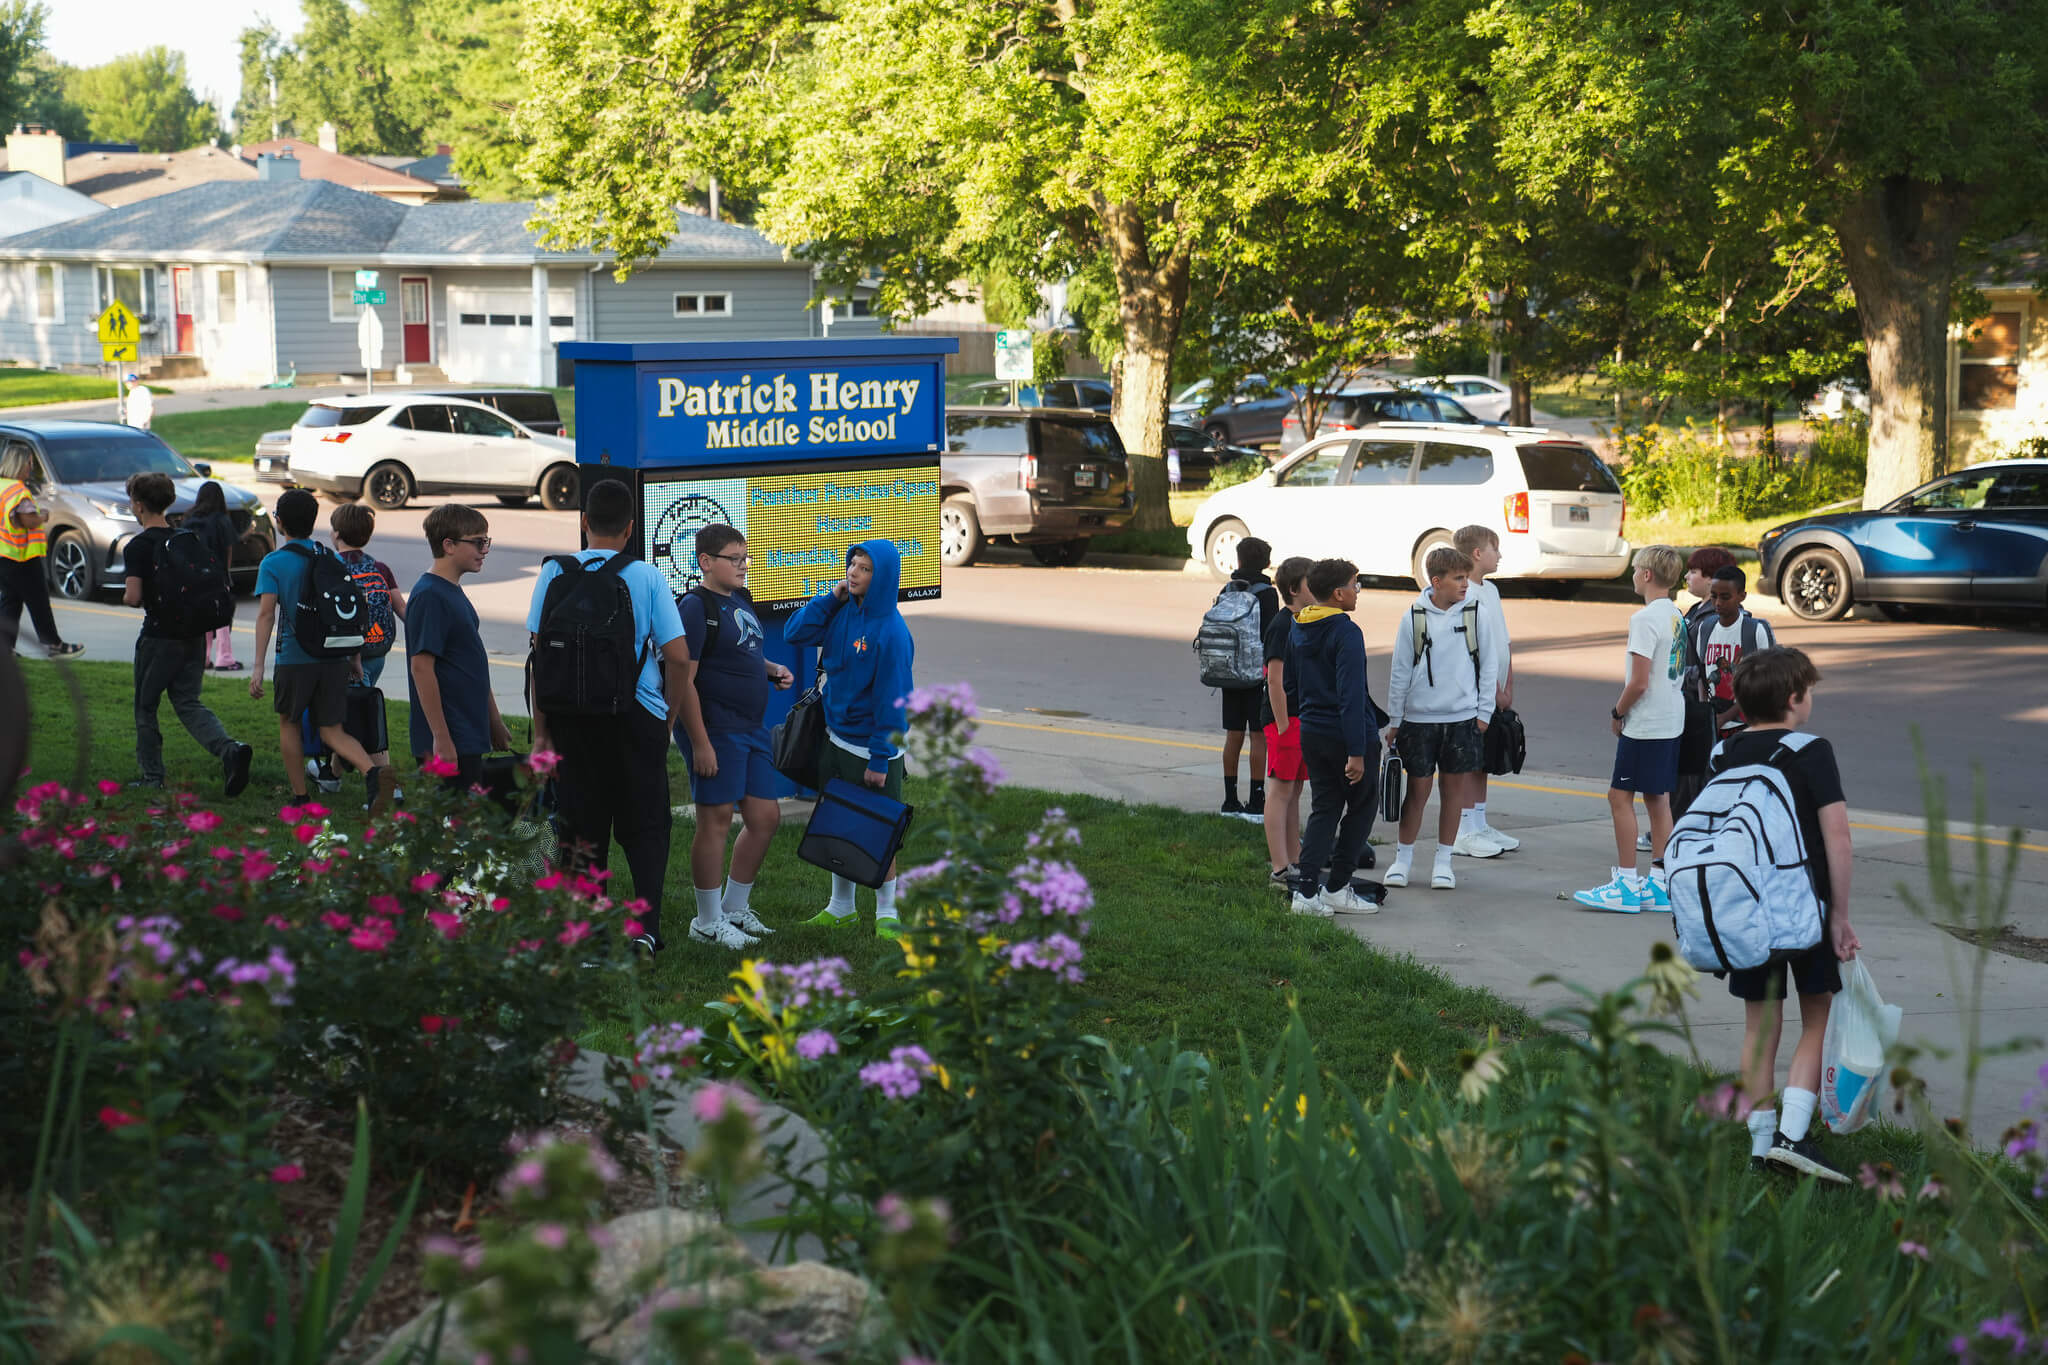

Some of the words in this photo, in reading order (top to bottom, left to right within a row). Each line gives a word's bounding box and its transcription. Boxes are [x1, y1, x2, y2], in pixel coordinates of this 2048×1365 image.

[998, 335, 1006, 347] 2
[657, 374, 798, 417] Patrick
[808, 372, 920, 415] Henry
[706, 418, 800, 449] Middle
[807, 412, 897, 444] School
[751, 485, 818, 506] Panther
[824, 480, 890, 501] Preview
[893, 479, 937, 502] Open
[816, 514, 873, 533] House
[766, 545, 840, 568] Monday,
[907, 588, 938, 599] GALAXY
[1705, 643, 1744, 665] ORDA
